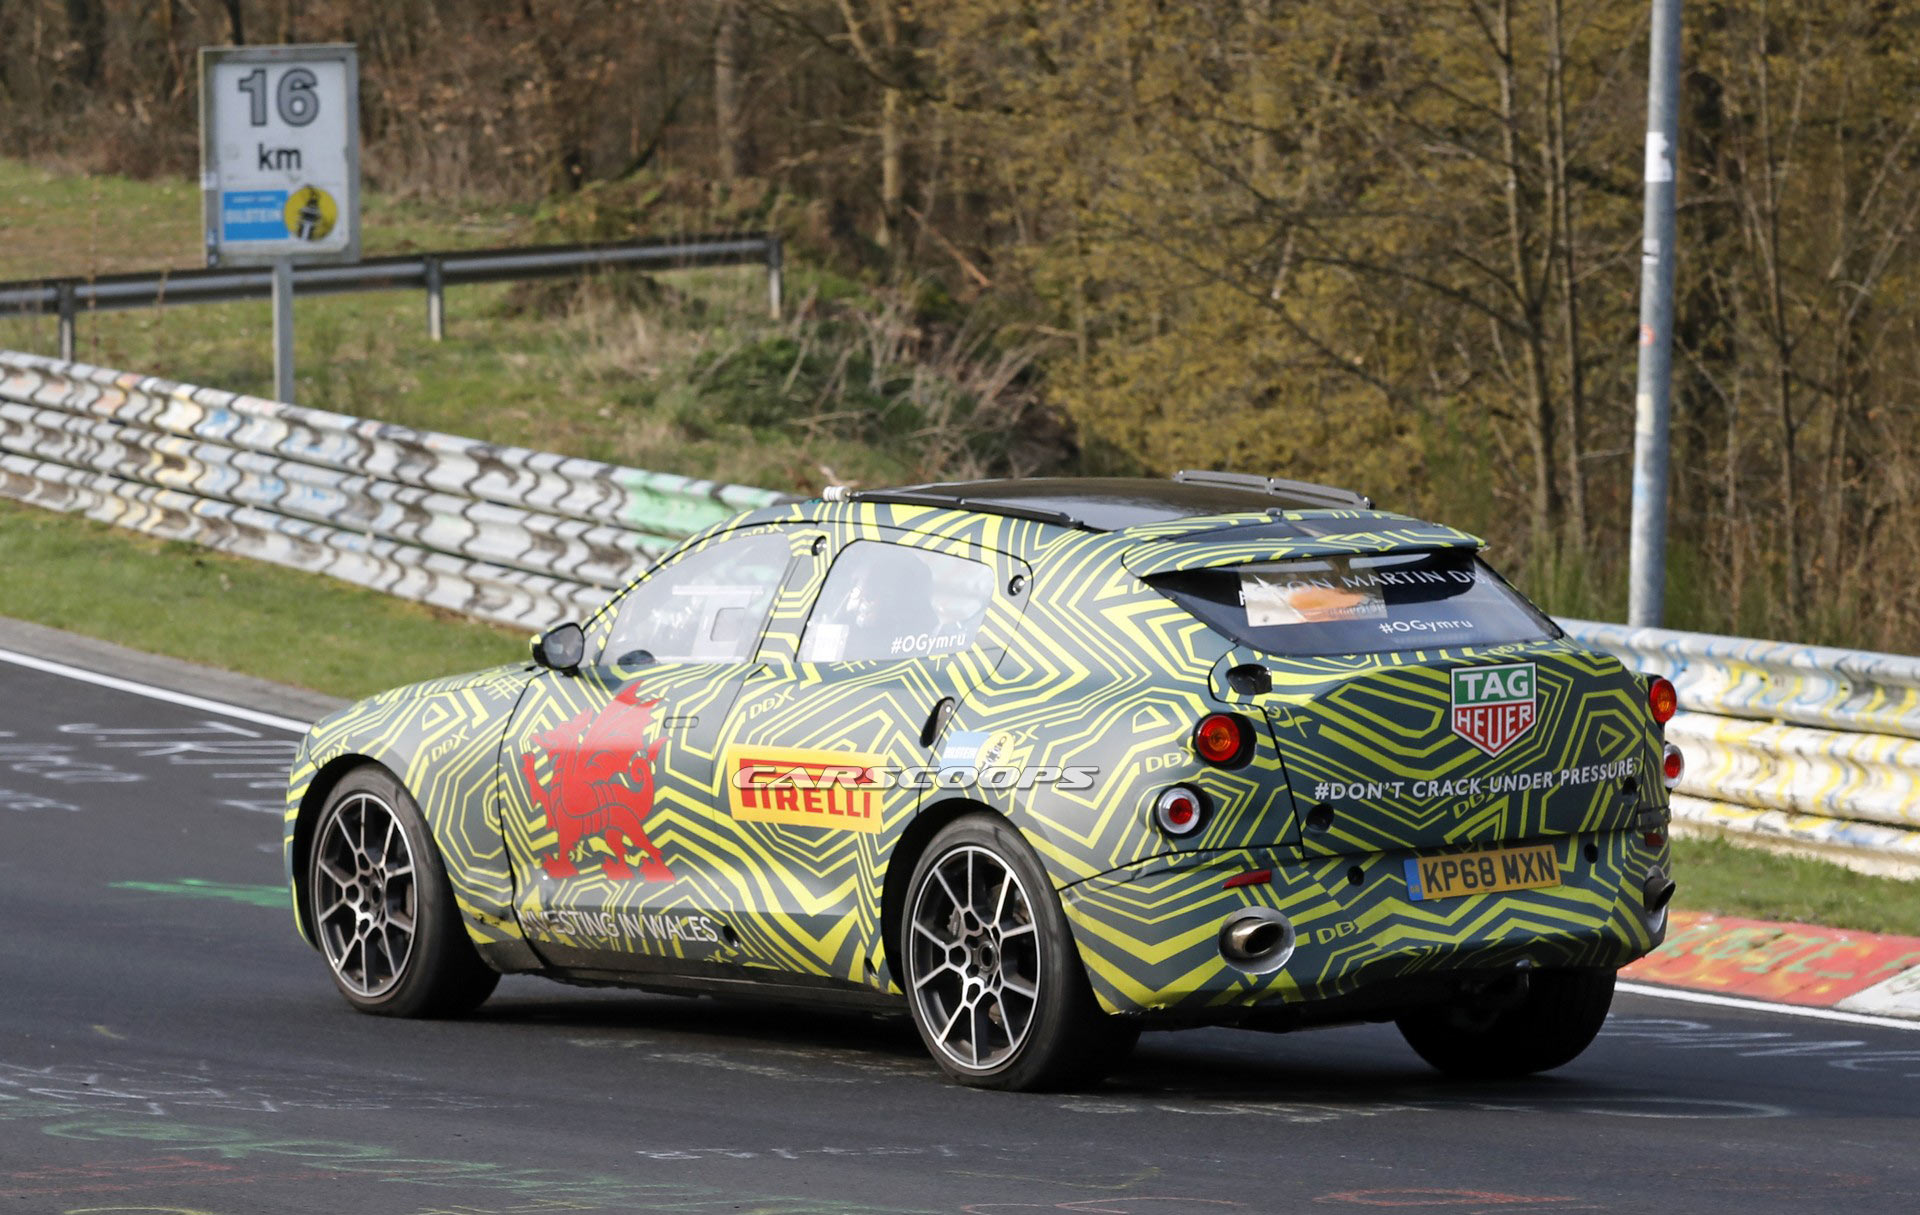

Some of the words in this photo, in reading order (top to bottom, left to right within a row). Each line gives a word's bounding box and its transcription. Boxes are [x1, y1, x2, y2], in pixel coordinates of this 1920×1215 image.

[238, 68, 320, 127] 16
[258, 142, 303, 171] km
[1340, 570, 1447, 588] MARTIN
[890, 631, 966, 654] #OGymru
[1378, 619, 1474, 635] #OGymru
[1459, 670, 1529, 701] TAG
[1457, 704, 1532, 750] HEUER
[740, 758, 874, 819] PIRELLI
[1314, 781, 1405, 801] #DON'T
[1412, 777, 1482, 799] CRACK
[1489, 771, 1554, 793] UNDER
[1560, 757, 1634, 787] PRESSURE
[1422, 856, 1497, 893] KP68
[1501, 850, 1556, 885] MXN
[617, 913, 645, 940] IN
[643, 914, 719, 943] WALES
